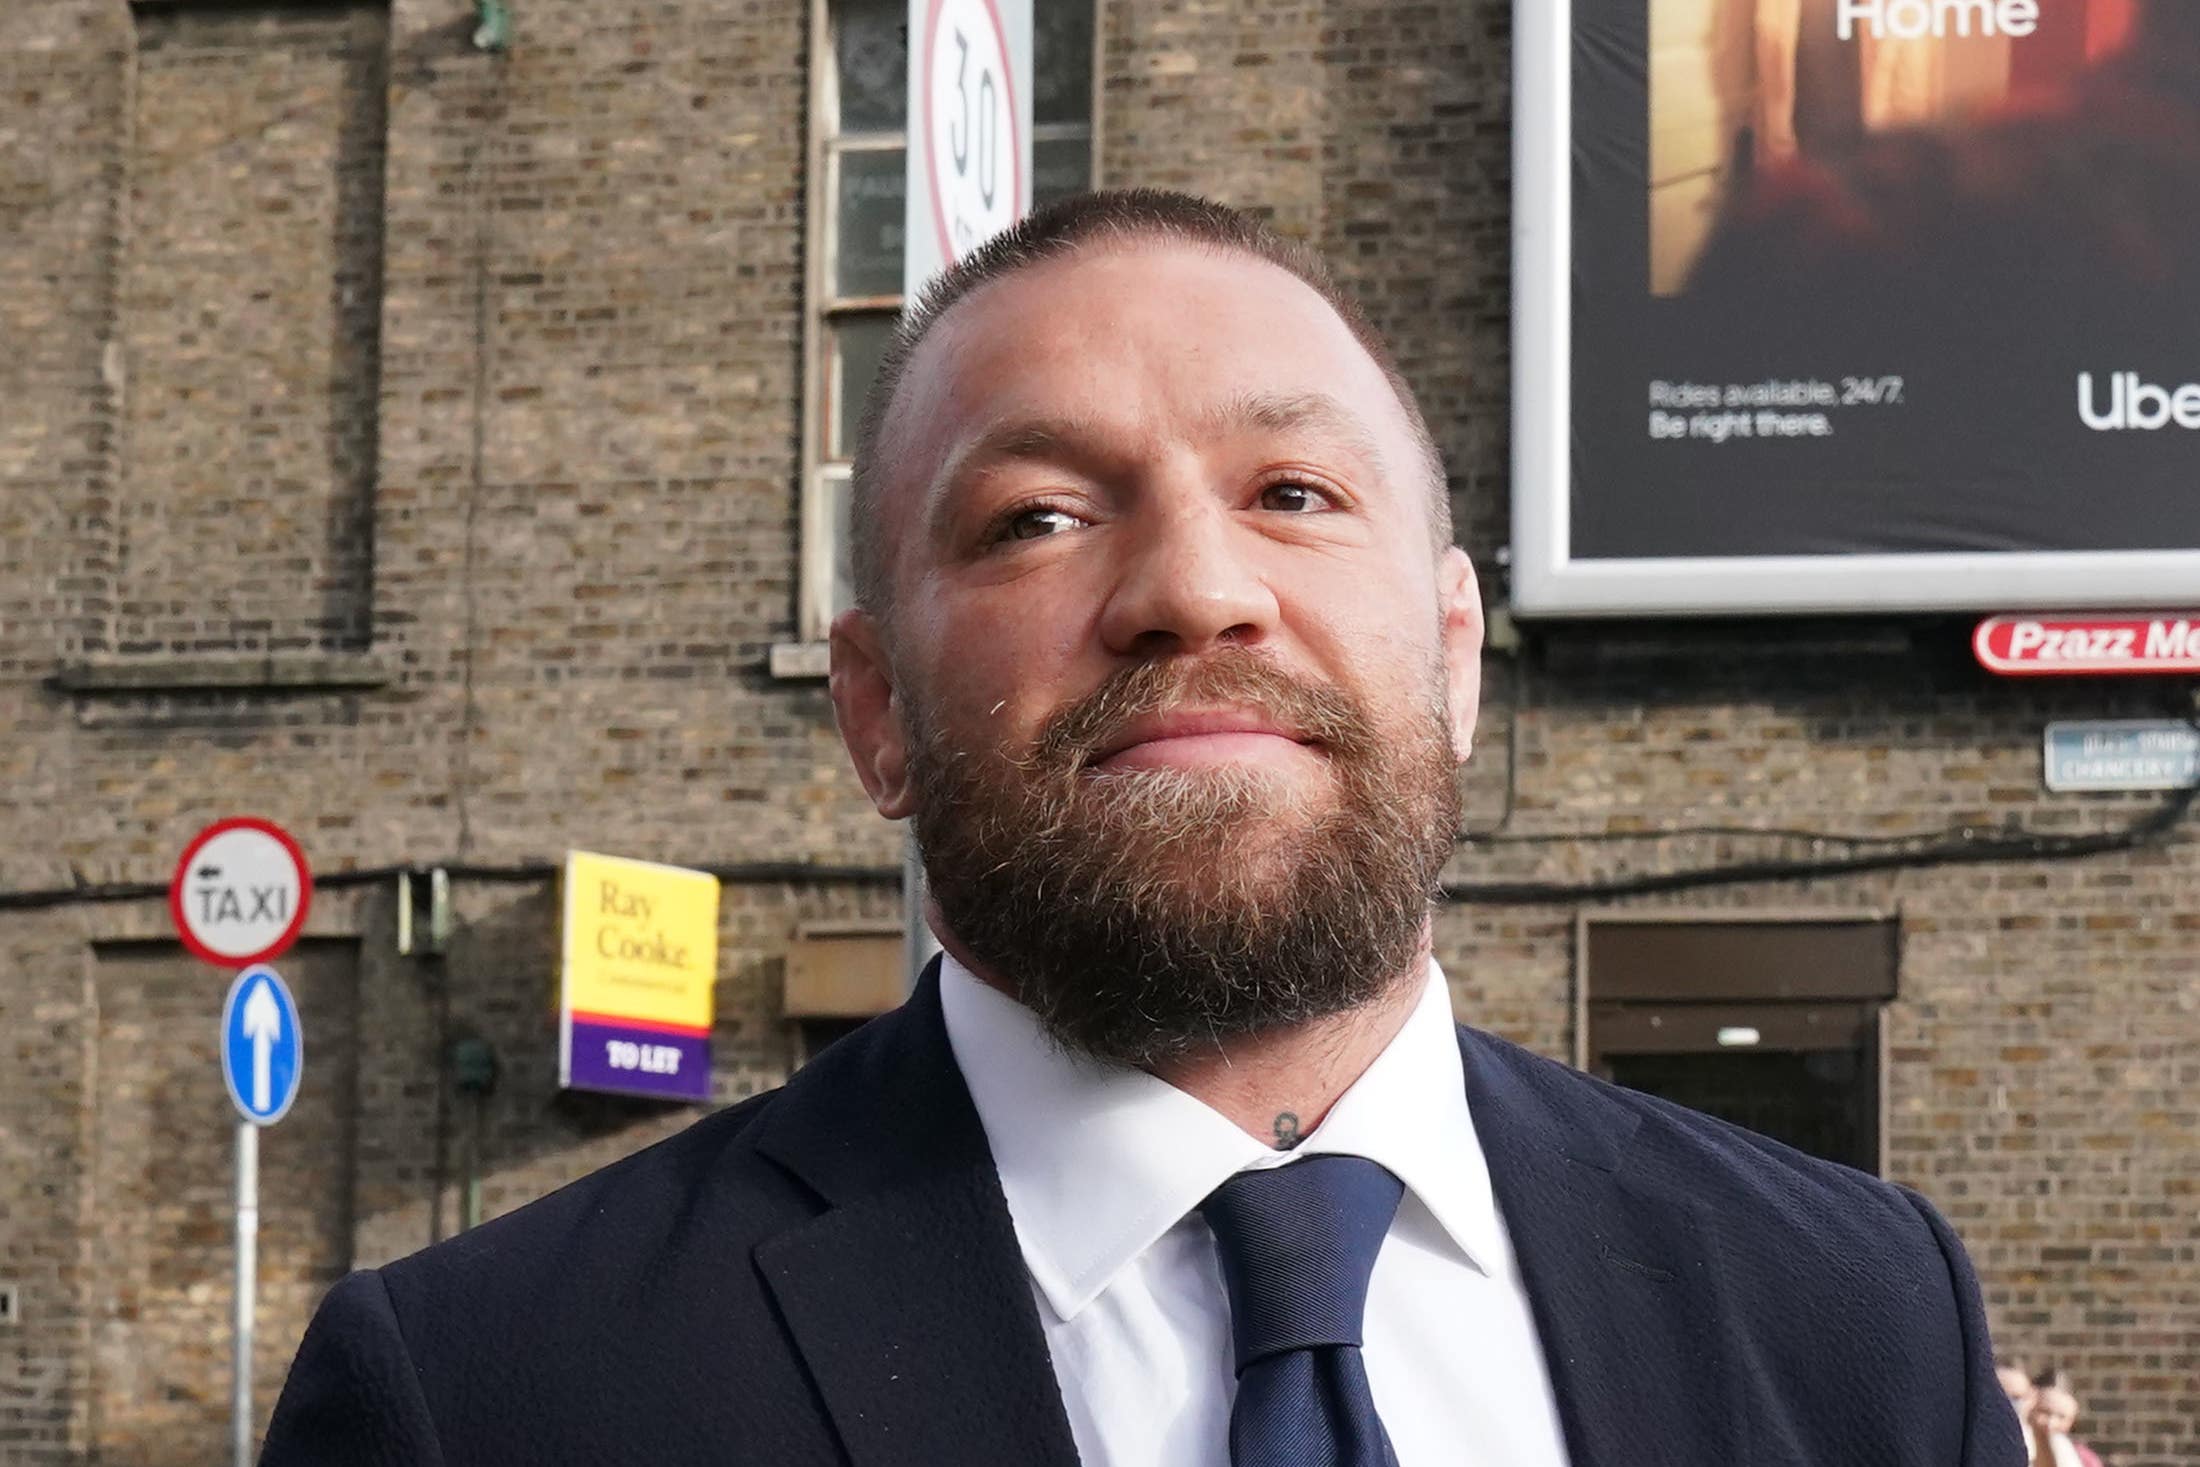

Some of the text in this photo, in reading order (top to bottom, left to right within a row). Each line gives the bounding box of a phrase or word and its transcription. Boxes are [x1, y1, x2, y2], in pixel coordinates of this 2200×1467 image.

[1837, 0, 2040, 40] Home
[950, 26, 996, 212] 30
[1649, 380, 1721, 407] Rides
[1649, 409, 1688, 438] Be
[1689, 408, 1754, 443] right
[2008, 621, 2136, 659] Pzazz
[197, 885, 288, 922] TAXI
[600, 880, 651, 931] Ray
[597, 924, 688, 969] Cooke
[606, 1040, 683, 1075] TO LET
